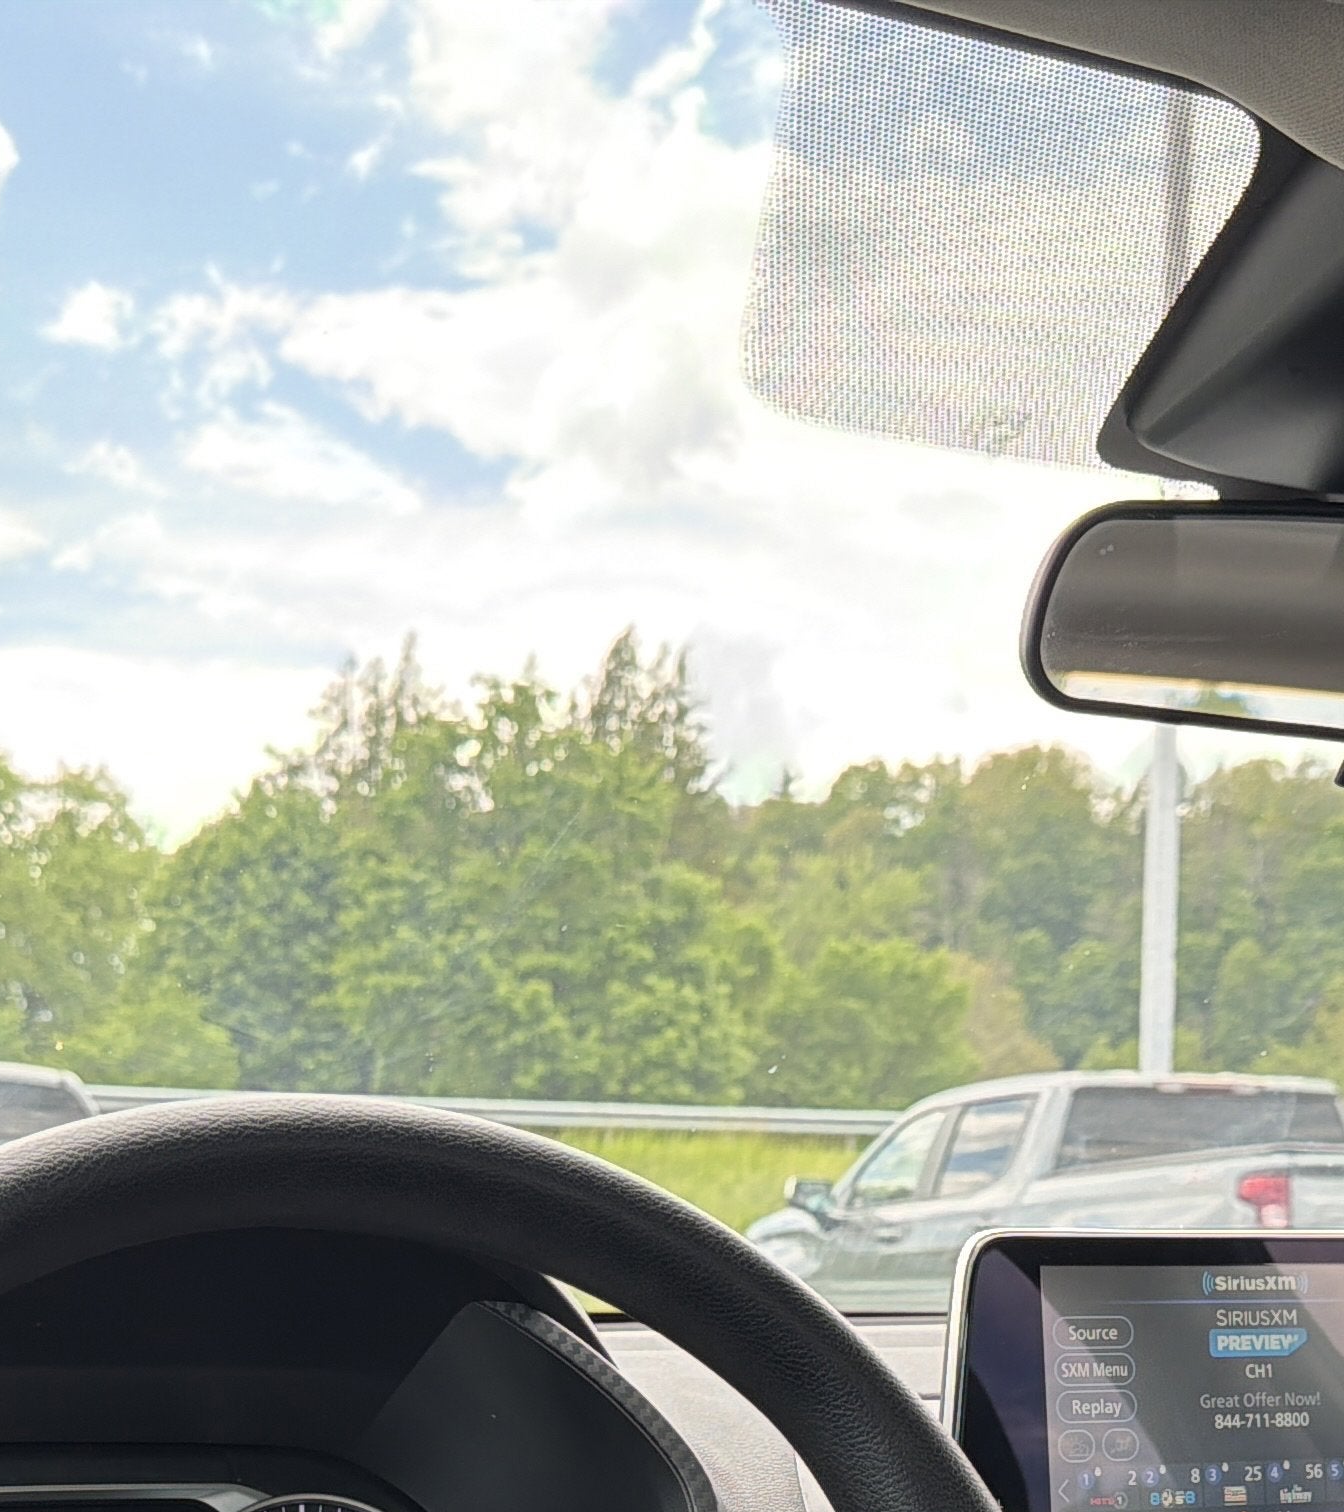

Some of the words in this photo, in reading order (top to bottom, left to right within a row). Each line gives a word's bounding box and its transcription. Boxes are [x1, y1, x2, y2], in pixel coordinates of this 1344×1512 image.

[1068, 1325, 1119, 1341] Source
[1216, 1334, 1298, 1351] PREVIEW
[1060, 1363, 1090, 1378] SXM
[1092, 1362, 1128, 1377] Menu
[1244, 1363, 1273, 1379] CH1
[1071, 1399, 1122, 1418] Replay
[1199, 1392, 1239, 1410] Great
[1243, 1392, 1281, 1408] Offer
[1284, 1391, 1322, 1407] Now!
[1214, 1411, 1311, 1430] 844-711-8800
[1127, 1470, 1137, 1486] 2
[1146, 1471, 1155, 1483] 2
[1190, 1468, 1201, 1484] 8
[1208, 1468, 1217, 1481] 3
[1244, 1465, 1263, 1482] 25
[1270, 1466, 1279, 1479] 4
[1305, 1463, 1324, 1479] 56
[1330, 1463, 1339, 1477] 5
[1082, 1474, 1090, 1486] 1
